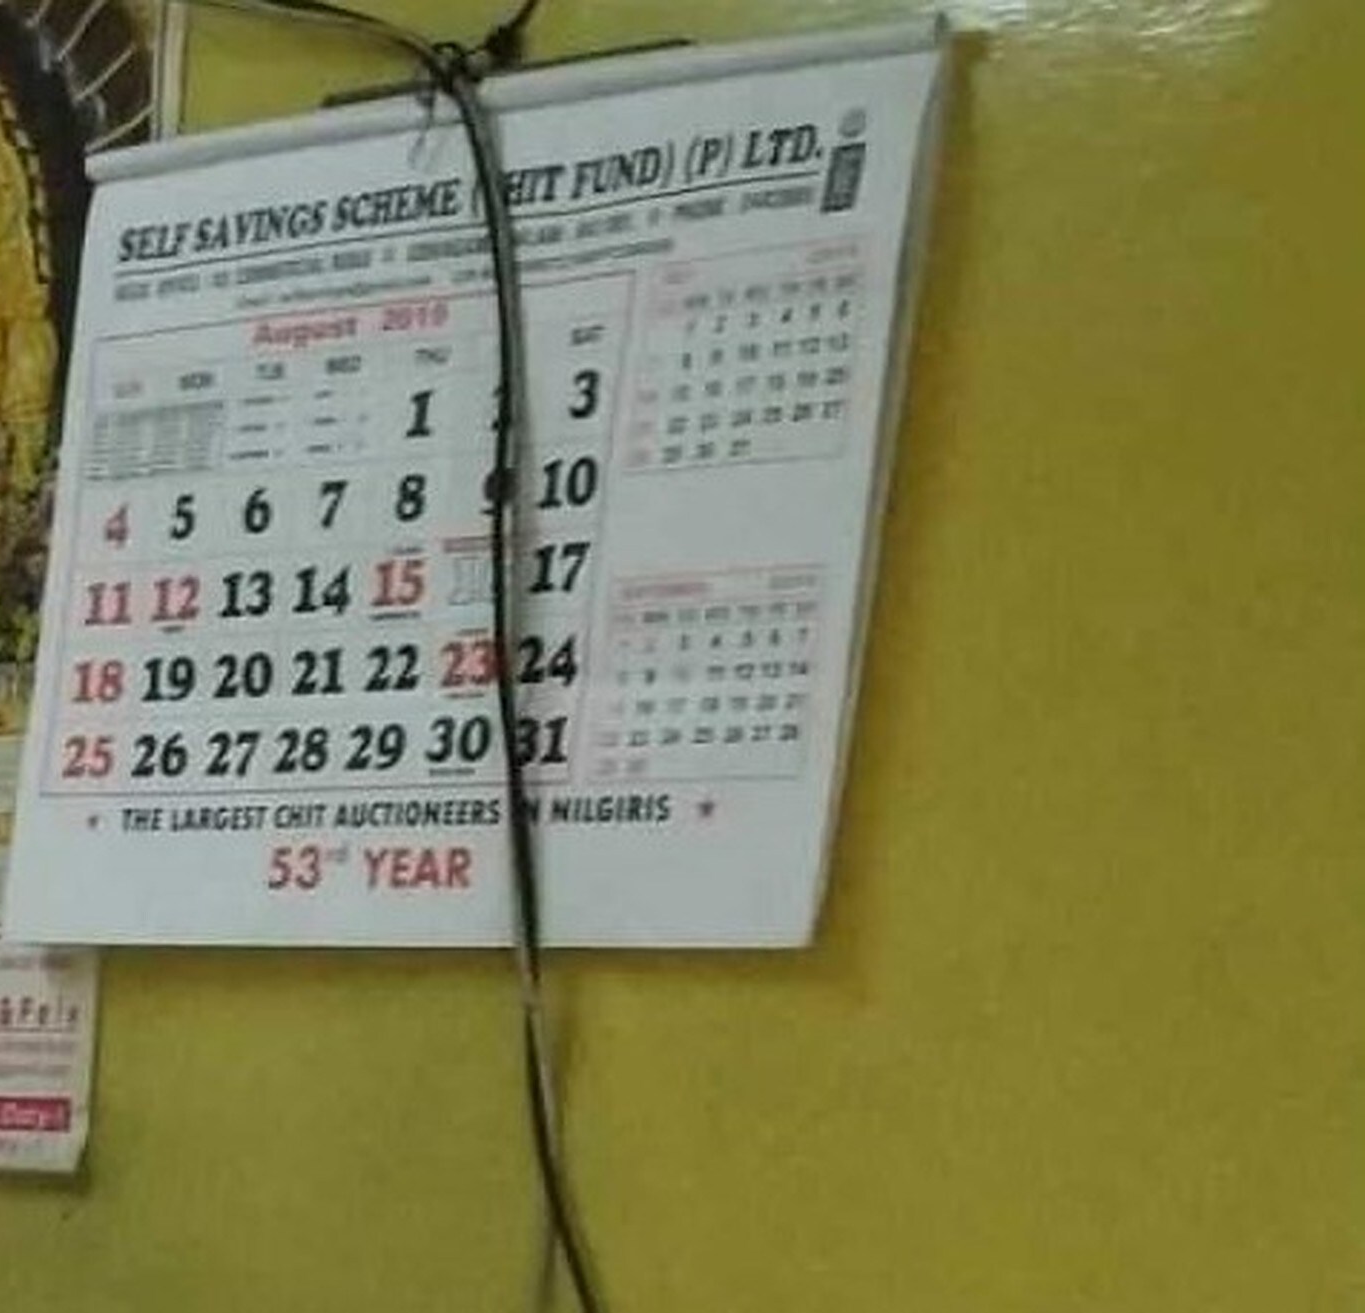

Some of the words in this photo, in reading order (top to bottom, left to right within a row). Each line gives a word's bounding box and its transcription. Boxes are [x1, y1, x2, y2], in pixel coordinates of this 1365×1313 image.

[118, 224, 191, 262] SELF
[194, 201, 328, 252] SAVINGS
[332, 178, 462, 231] SCHEME
[472, 165, 566, 218] (HIT
[570, 139, 674, 200] FUND)
[685, 135, 733, 183] (P)
[740, 123, 822, 169] LTD.
[252, 316, 358, 349] August
[406, 389, 435, 438] 1
[569, 369, 600, 420] 3
[106, 503, 129, 548] 4
[170, 494, 196, 541] 5
[243, 487, 272, 535] 6
[320, 480, 349, 530] 7
[396, 474, 427, 523] 8
[537, 456, 598, 510] 10
[84, 581, 132, 626] 11
[150, 575, 201, 623] 12
[218, 570, 274, 618] 13
[292, 566, 352, 617] 14
[371, 558, 425, 607] 15
[529, 541, 591, 595] 17
[74, 660, 125, 704] 18
[142, 656, 196, 702] 19
[213, 652, 274, 699] 20
[292, 649, 344, 695] 21
[365, 644, 420, 692] 22
[441, 639, 502, 687] 23
[517, 632, 578, 687] 24
[62, 735, 114, 779] 25
[131, 732, 188, 778] 26
[205, 730, 261, 777] 27
[273, 727, 329, 774] 28
[344, 722, 407, 771] 29
[426, 715, 492, 763] 30
[516, 715, 568, 767] 31
[122, 807, 164, 832] THE
[171, 806, 268, 832] LARGEST
[273, 804, 327, 829] CHIT
[333, 799, 502, 828] AUCTIONEERS
[551, 794, 671, 824] NILGIRIS
[364, 845, 473, 889] YEAR
